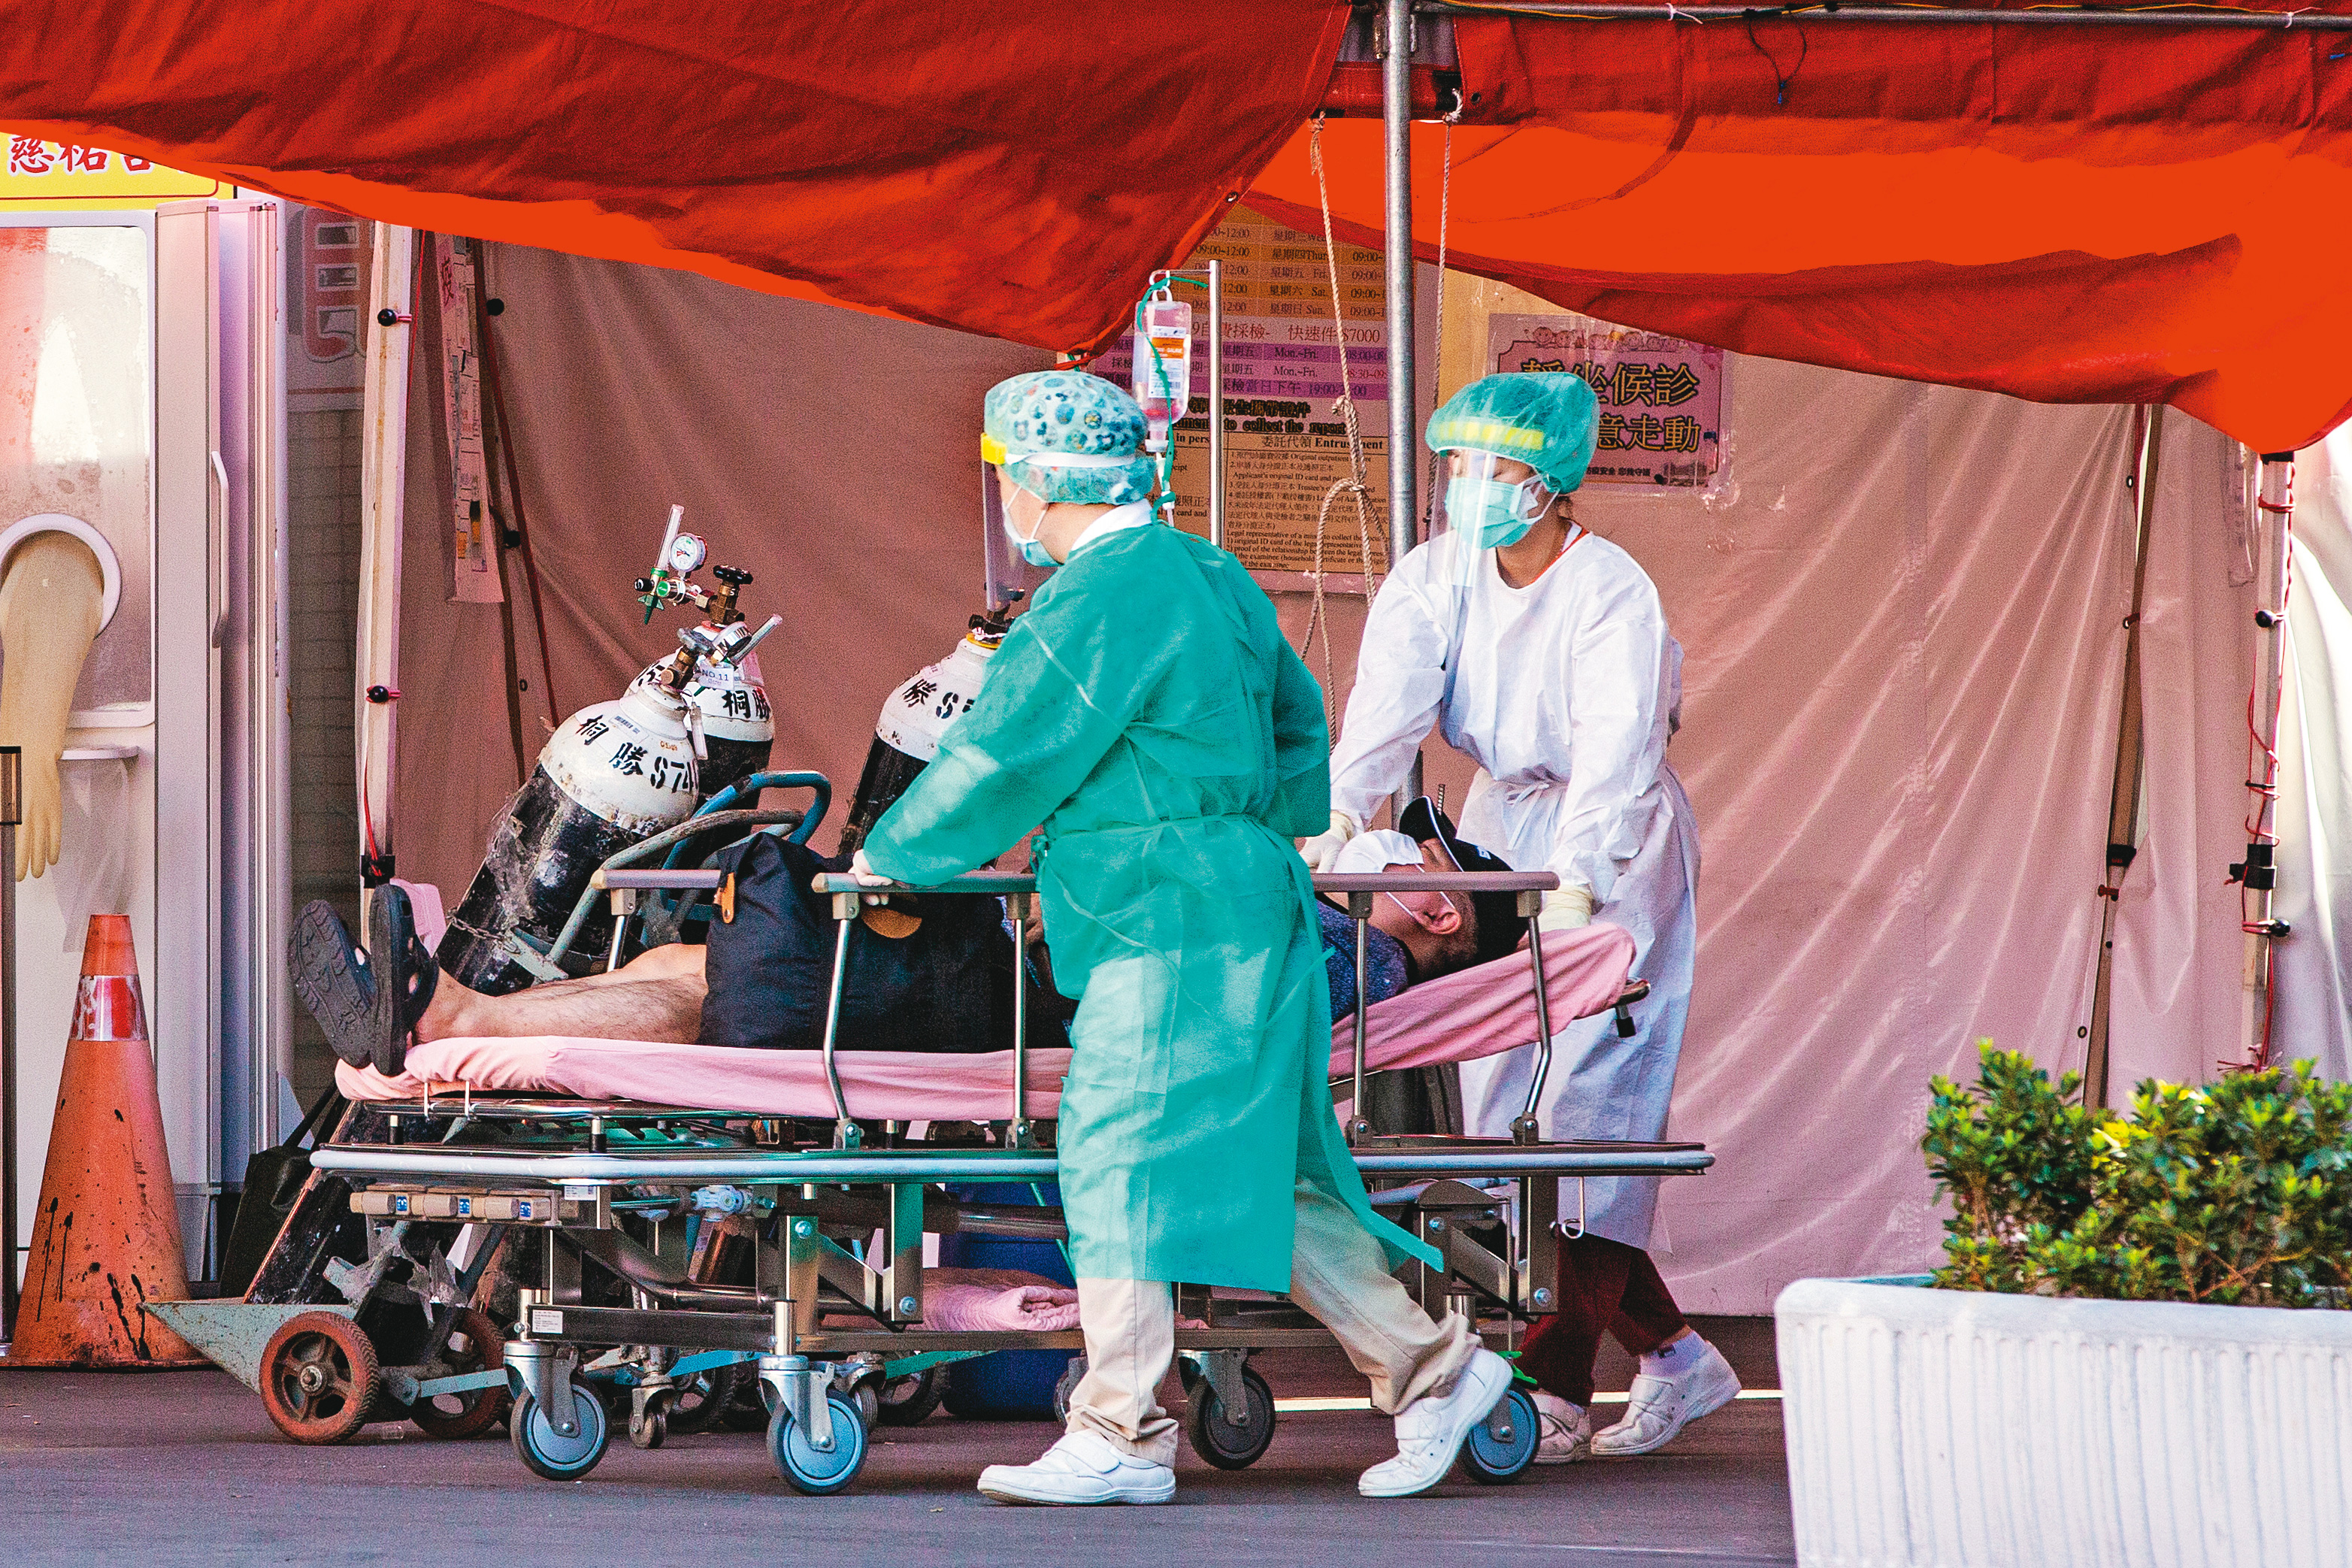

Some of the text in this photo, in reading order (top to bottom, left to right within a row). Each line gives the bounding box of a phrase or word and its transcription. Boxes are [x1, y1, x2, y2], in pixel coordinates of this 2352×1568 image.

[1224, 418, 1237, 431] to
[1243, 419, 1283, 433] collect
[1284, 419, 1304, 433] the
